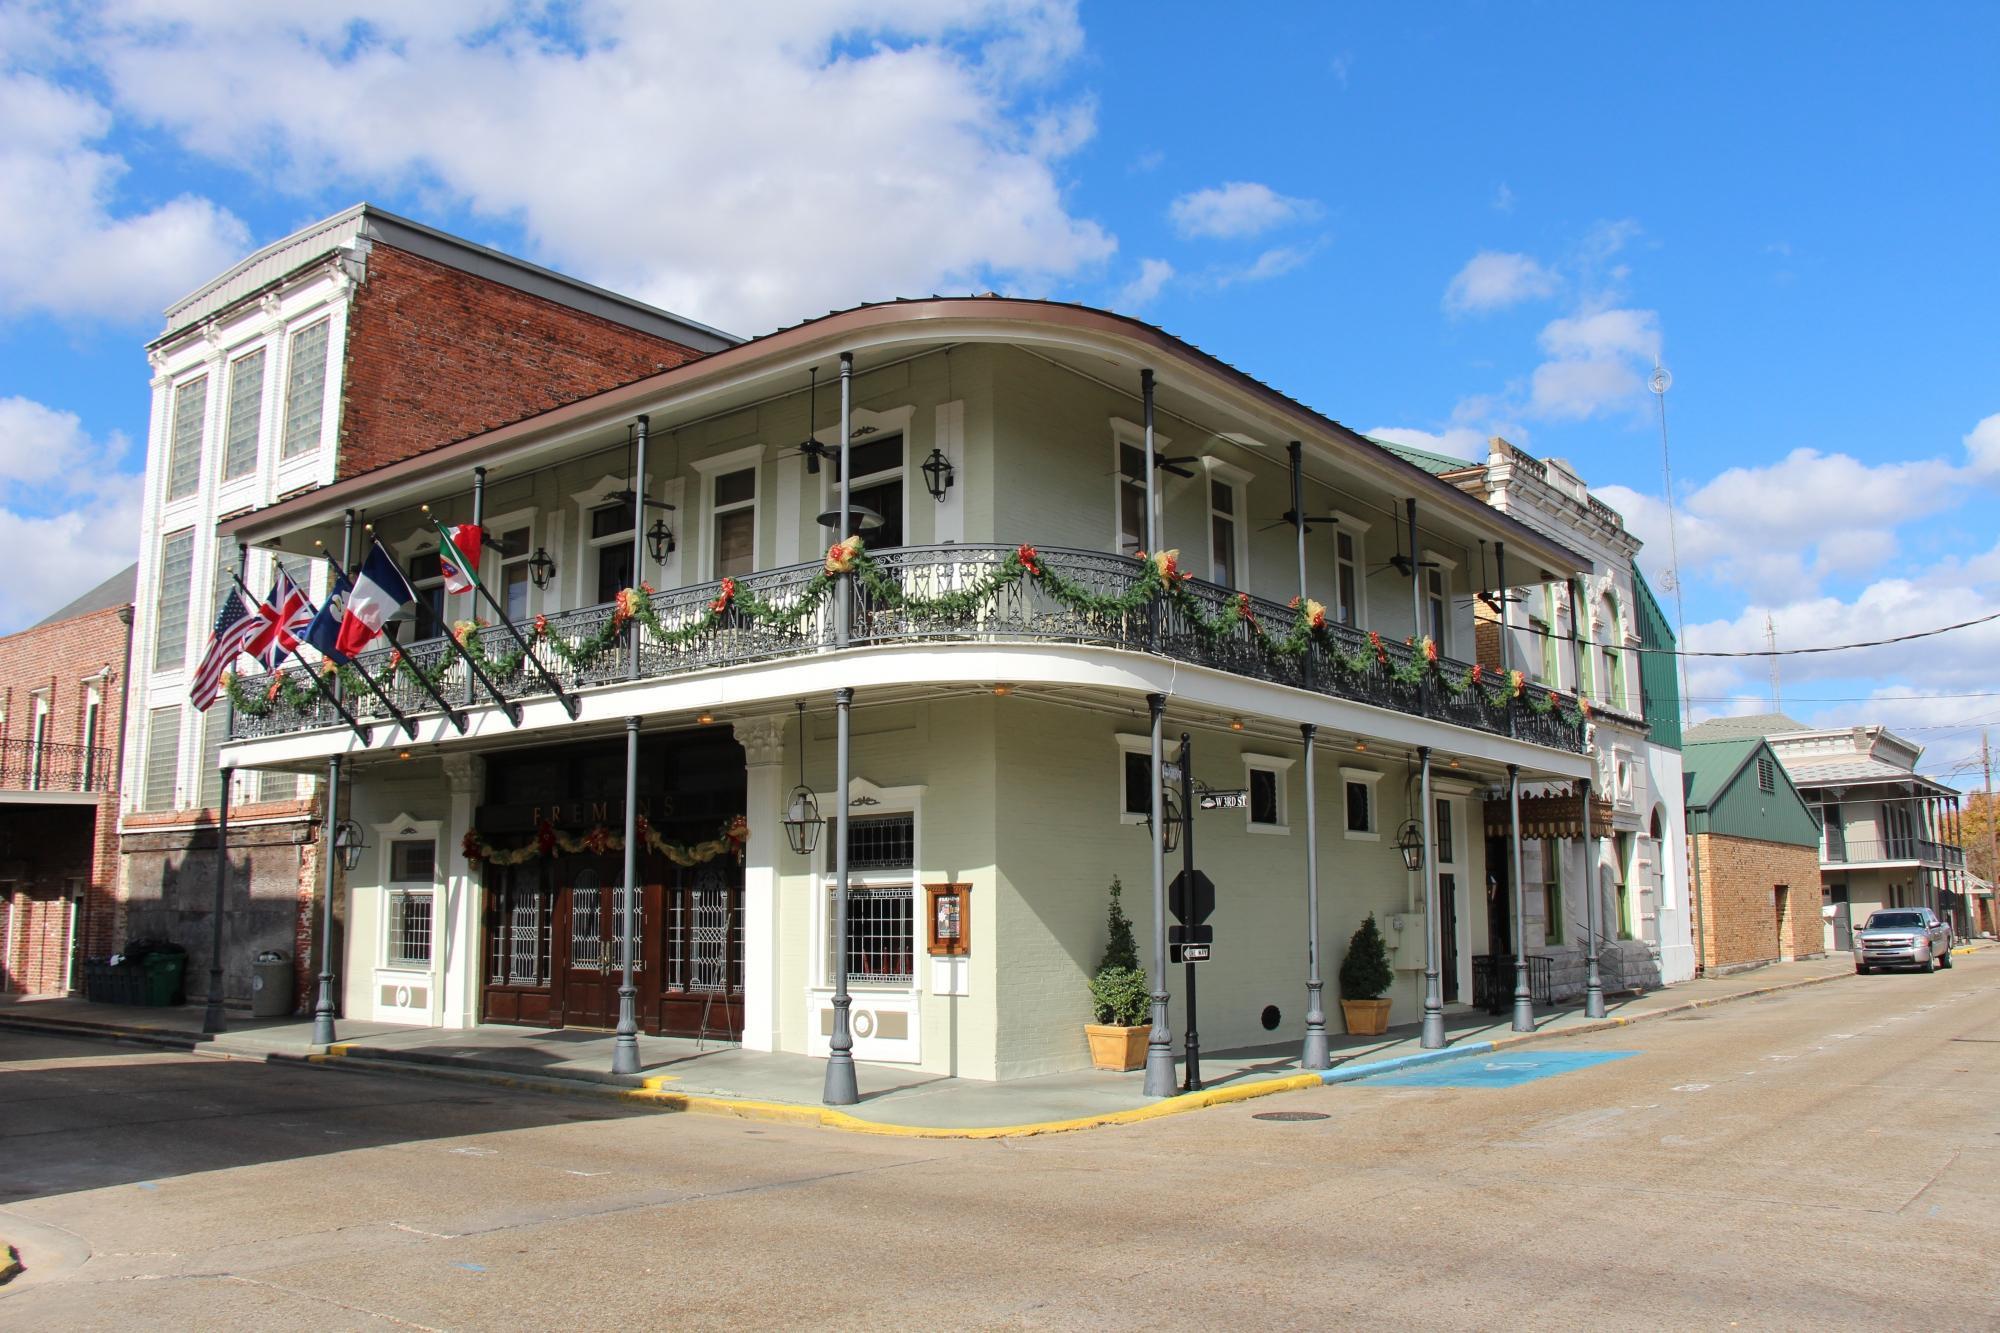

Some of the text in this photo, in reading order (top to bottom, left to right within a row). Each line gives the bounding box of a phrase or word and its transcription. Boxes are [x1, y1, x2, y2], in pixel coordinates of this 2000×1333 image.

[1216, 796, 1247, 807] W 3RD ST
